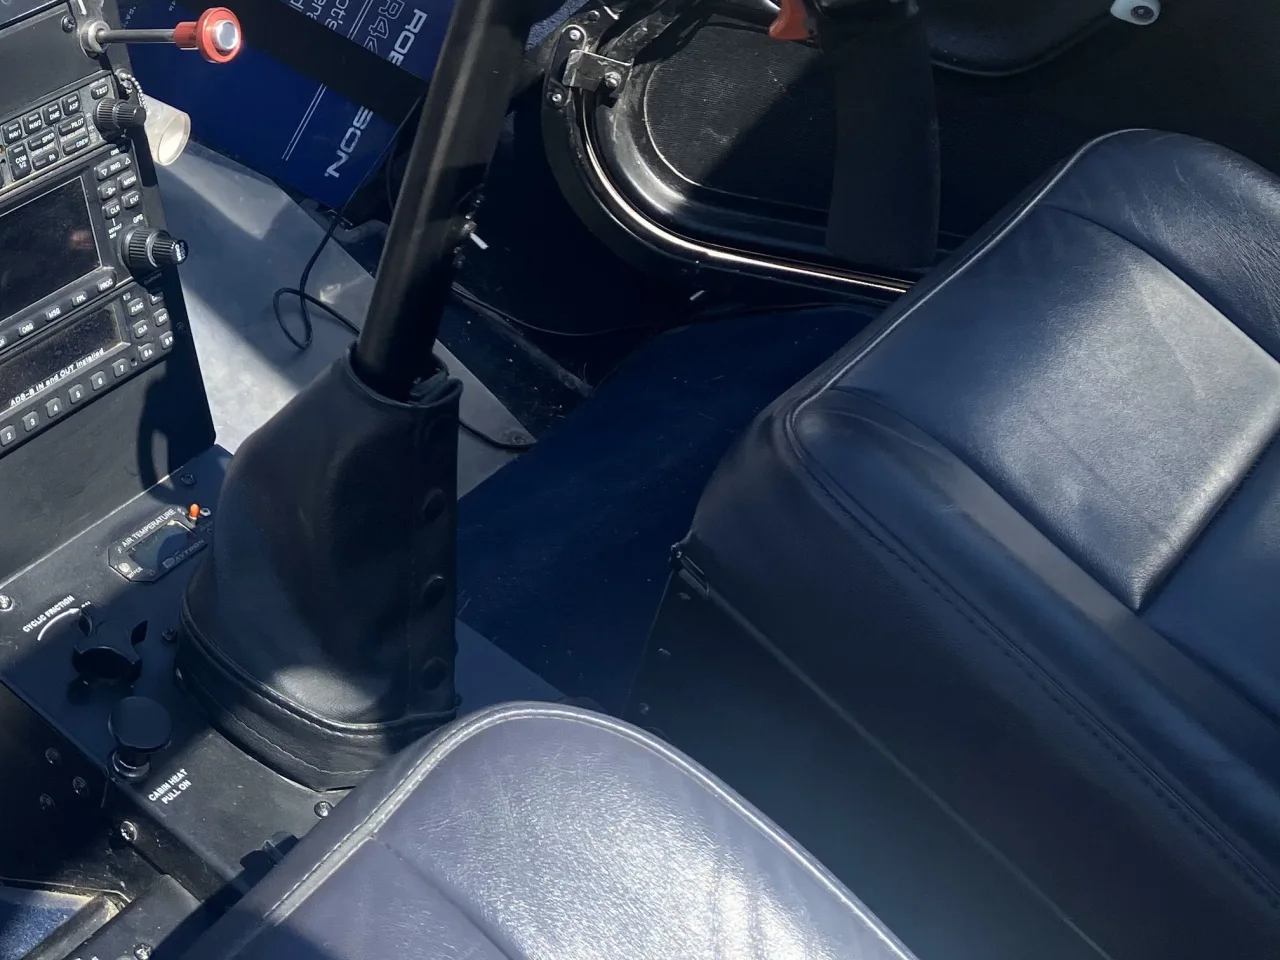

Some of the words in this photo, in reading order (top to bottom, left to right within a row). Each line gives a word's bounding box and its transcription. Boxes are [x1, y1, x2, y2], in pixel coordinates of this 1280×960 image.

[69, 103, 79, 111] ADF
[49, 110, 60, 121] DME
[28, 120, 42, 130] NAV2
[70, 118, 85, 129] PILOT
[8, 128, 21, 139] NAV1
[15, 155, 27, 164] COM
[110, 205, 120, 214] CLR
[133, 213, 144, 224] GPS
[100, 278, 113, 290] PROC
[48, 307, 61, 319] MSG
[131, 302, 144, 313] FUNC
[158, 313, 167, 322] ENT
[21, 322, 34, 333] OBS
[137, 324, 148, 334] CLR
[36, 382, 45, 393] IN
[45, 374, 59, 387] and
[59, 363, 75, 377] OUT
[121, 537, 133, 548] AIR
[132, 508, 176, 540] TEMPERATURE
[162, 538, 205, 569] DAVTRON
[22, 613, 47, 633] CYCLIC
[44, 594, 76, 619] FRICTION
[148, 782, 172, 801] CABIN
[167, 768, 188, 786] HEAT
[161, 789, 182, 805] PULL
[178, 779, 192, 790] ON
